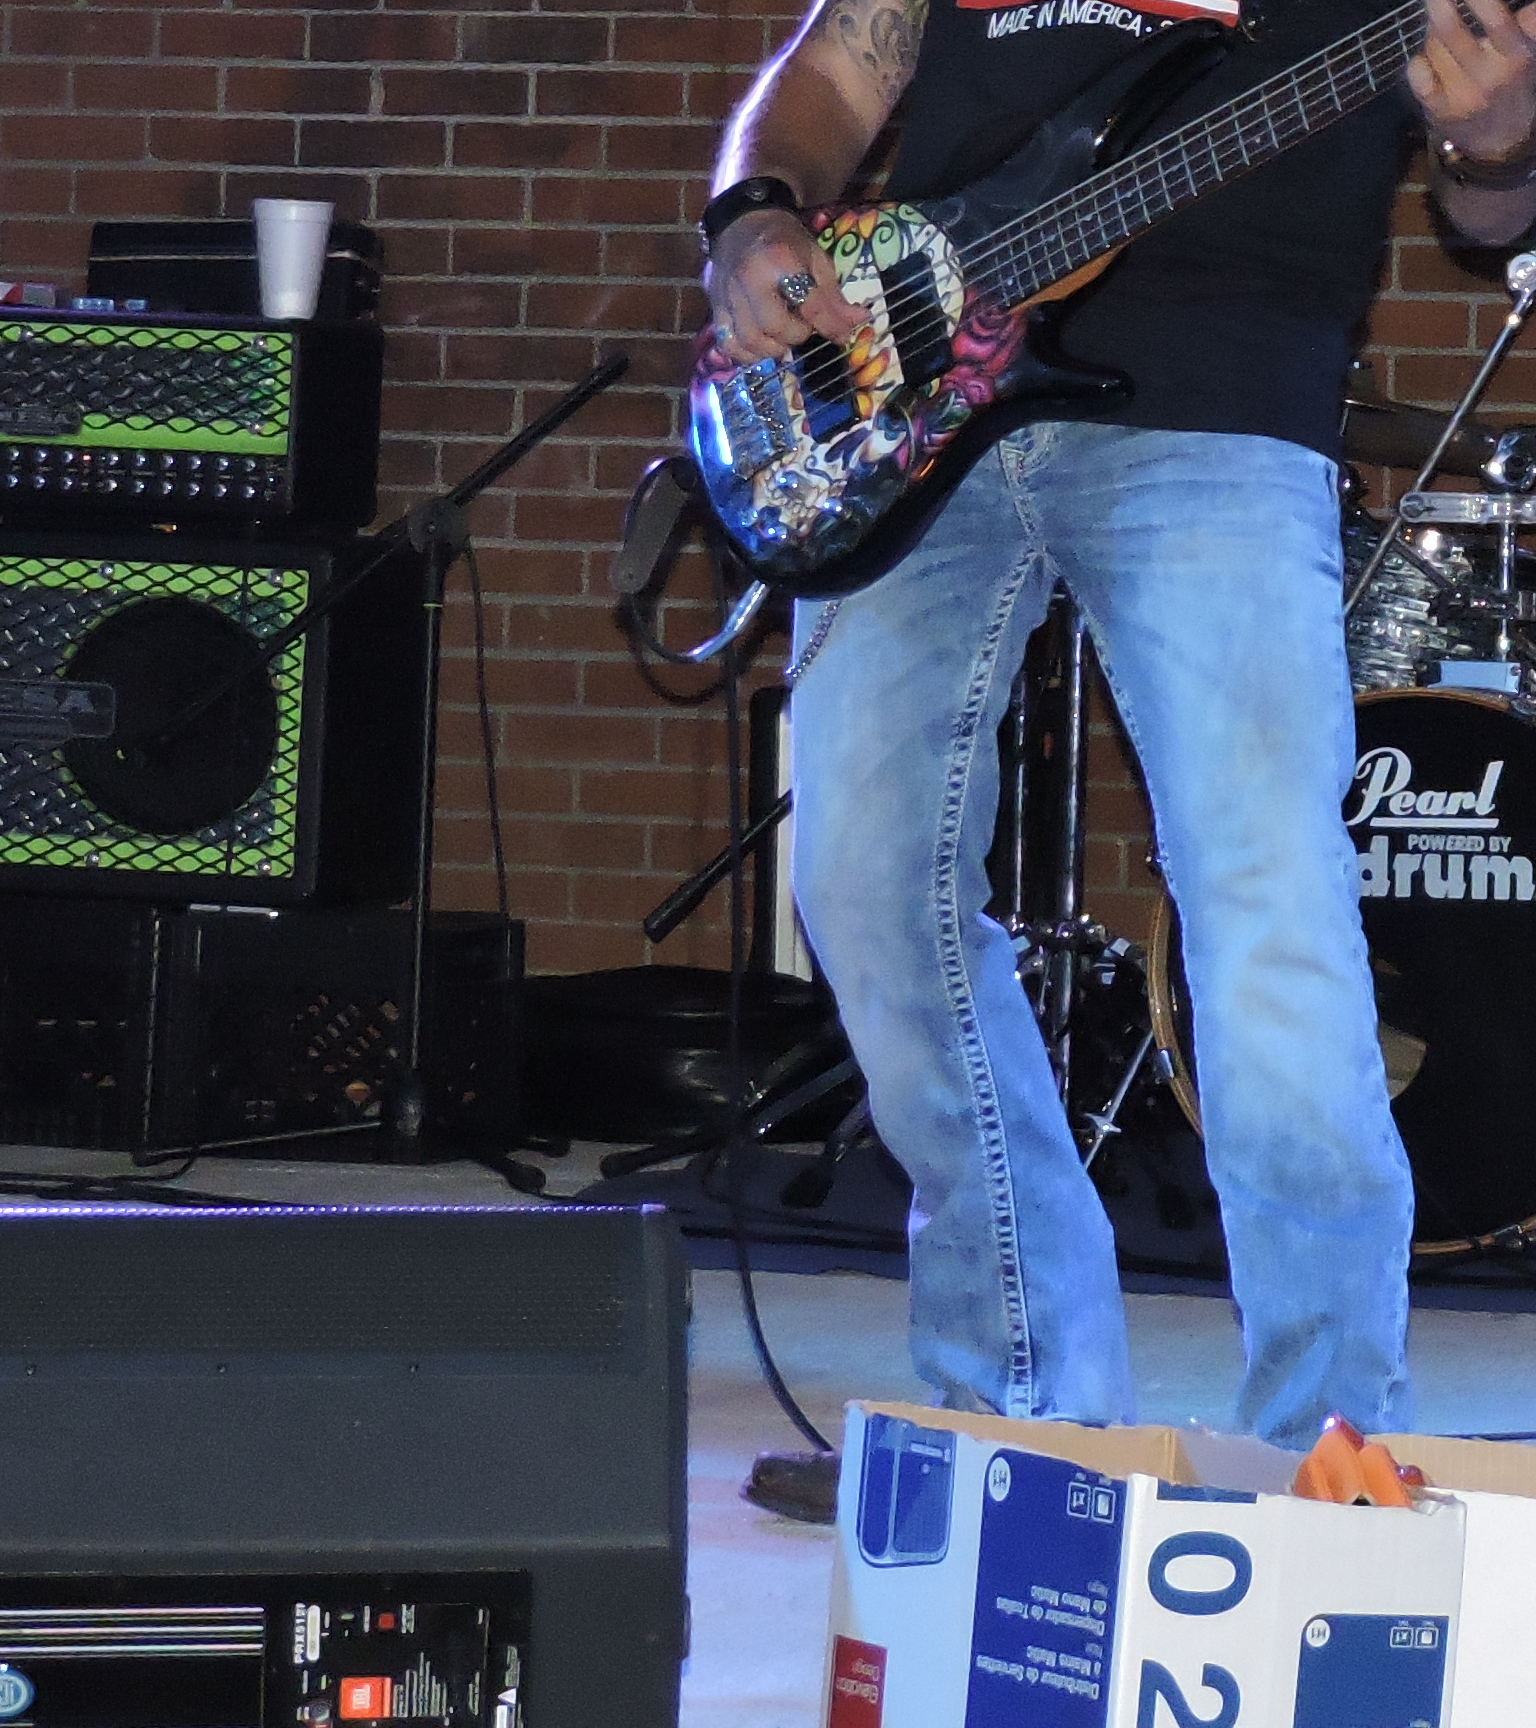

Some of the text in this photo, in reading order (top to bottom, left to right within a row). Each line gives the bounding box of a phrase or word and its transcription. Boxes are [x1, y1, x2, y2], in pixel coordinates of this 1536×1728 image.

[986, 4, 1039, 39] MADE
[1036, 0, 1057, 29] IN
[1345, 746, 1504, 827] Pearl
[1407, 834, 1511, 853] POWERED BY
